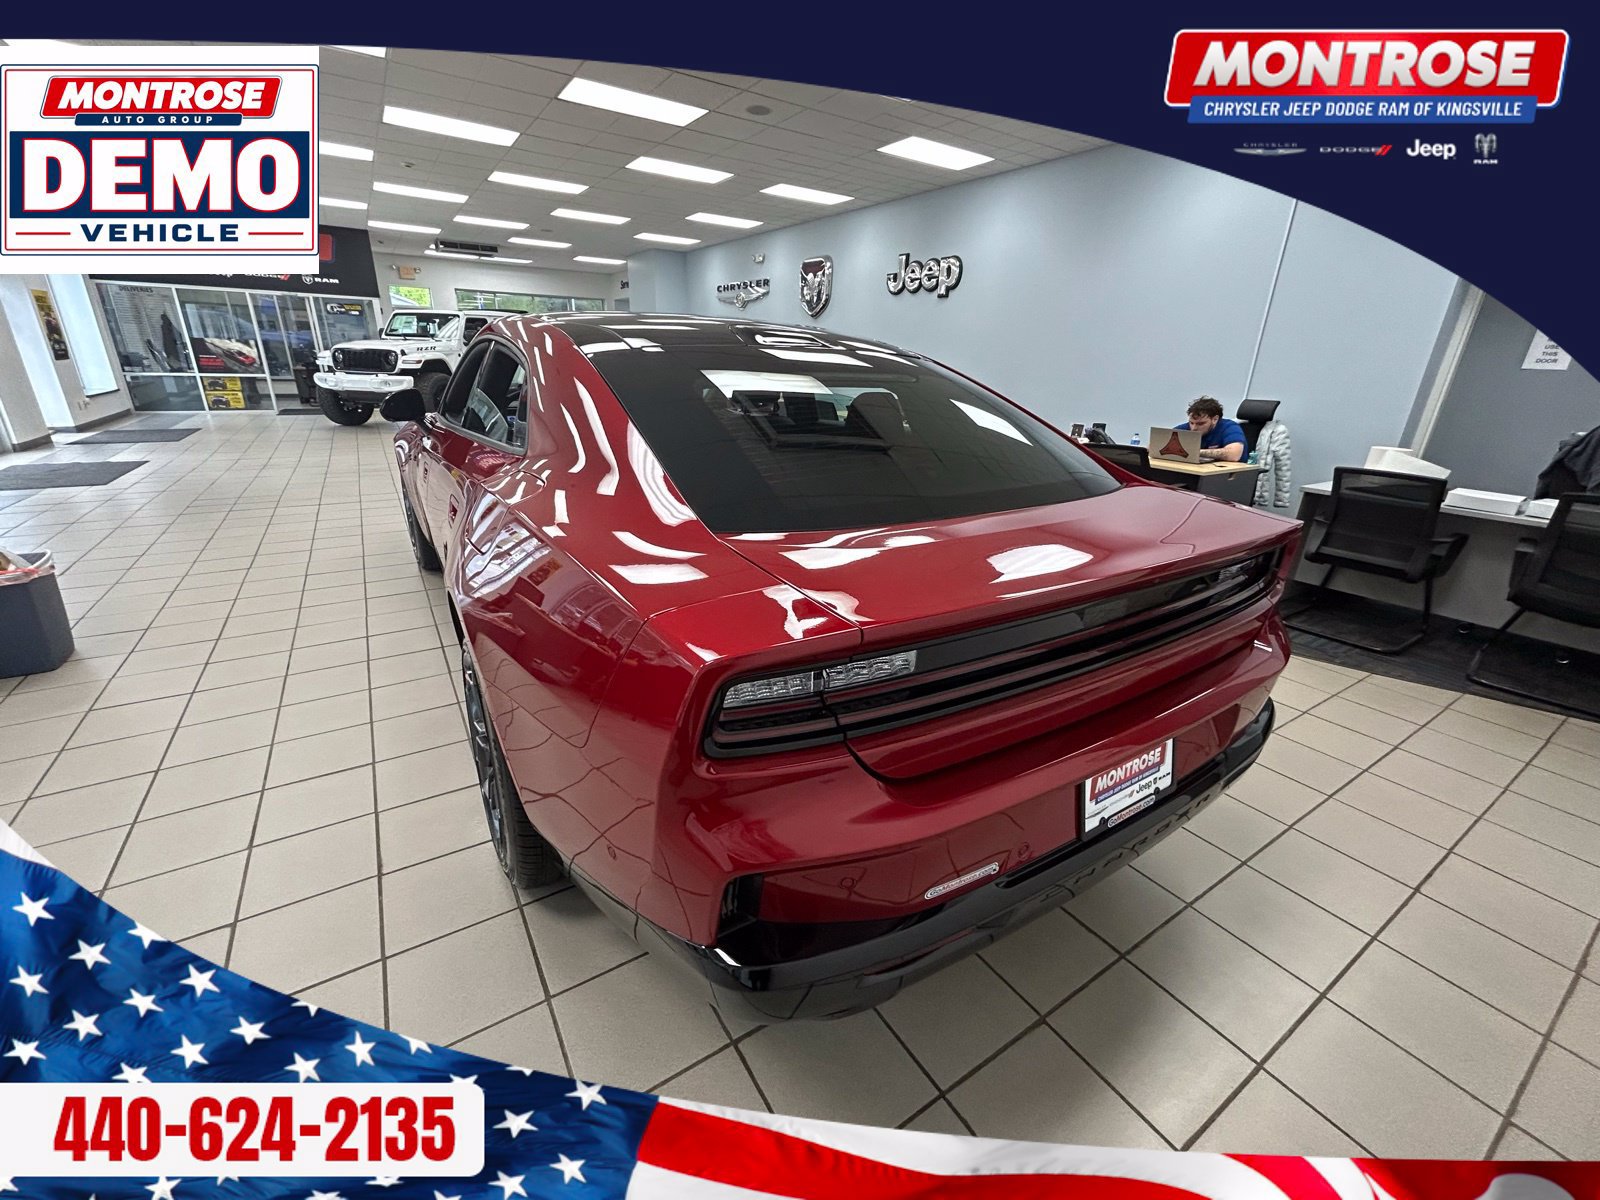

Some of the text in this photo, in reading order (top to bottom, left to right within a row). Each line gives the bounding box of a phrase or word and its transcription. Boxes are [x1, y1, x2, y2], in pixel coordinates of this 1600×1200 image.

[716, 279, 771, 293] CHRYSLER
[887, 253, 963, 298] Jeep
[1095, 746, 1162, 794] MONTROSE
[1136, 780, 1153, 794] Jeep
